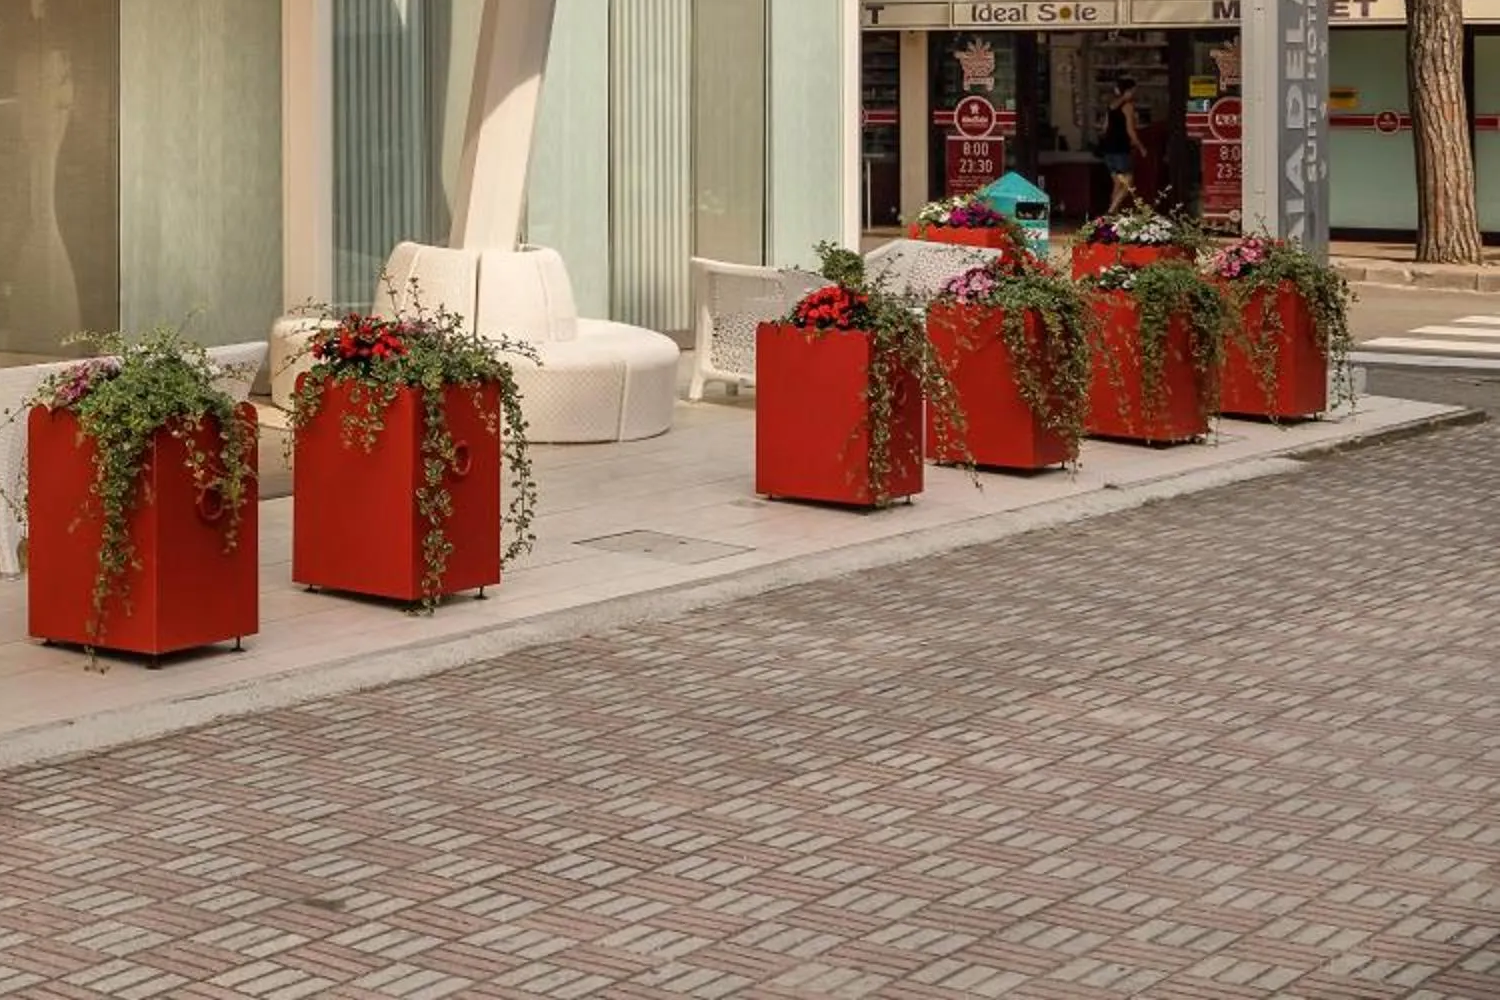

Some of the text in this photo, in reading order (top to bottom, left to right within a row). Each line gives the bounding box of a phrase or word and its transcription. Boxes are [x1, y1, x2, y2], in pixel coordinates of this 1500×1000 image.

[971, 3, 1097, 22] Ideal Sole
[1285, 16, 1304, 129] DEL
[1219, 145, 1241, 161] 8:0
[1307, 94, 1318, 182] SUITE
